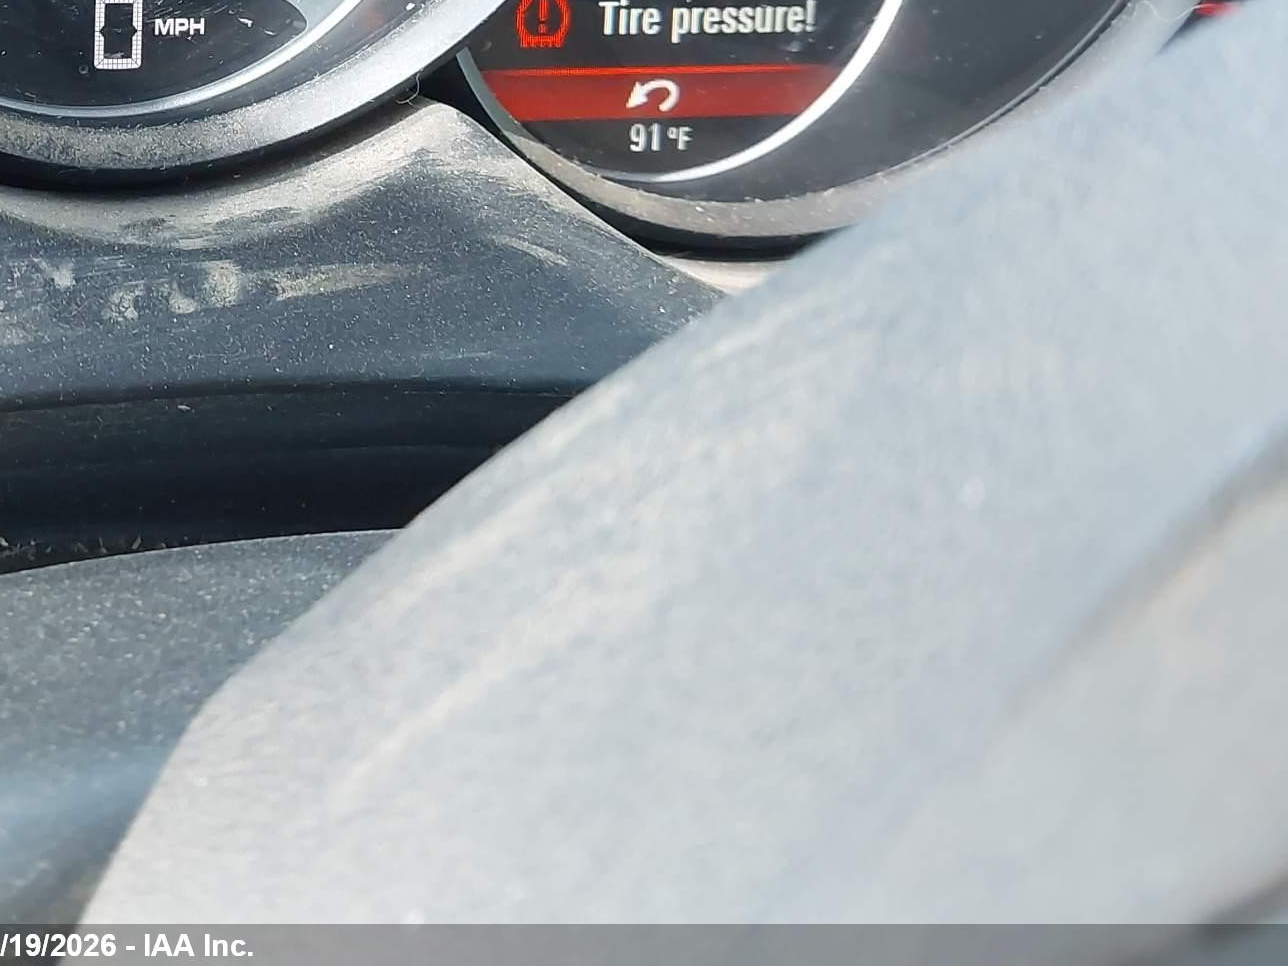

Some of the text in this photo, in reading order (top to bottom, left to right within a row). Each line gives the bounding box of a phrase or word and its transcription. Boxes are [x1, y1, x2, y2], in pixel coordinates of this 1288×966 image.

[154, 17, 205, 37] MPH
[671, 0, 817, 43] pressure!
[629, 123, 661, 152] 91
